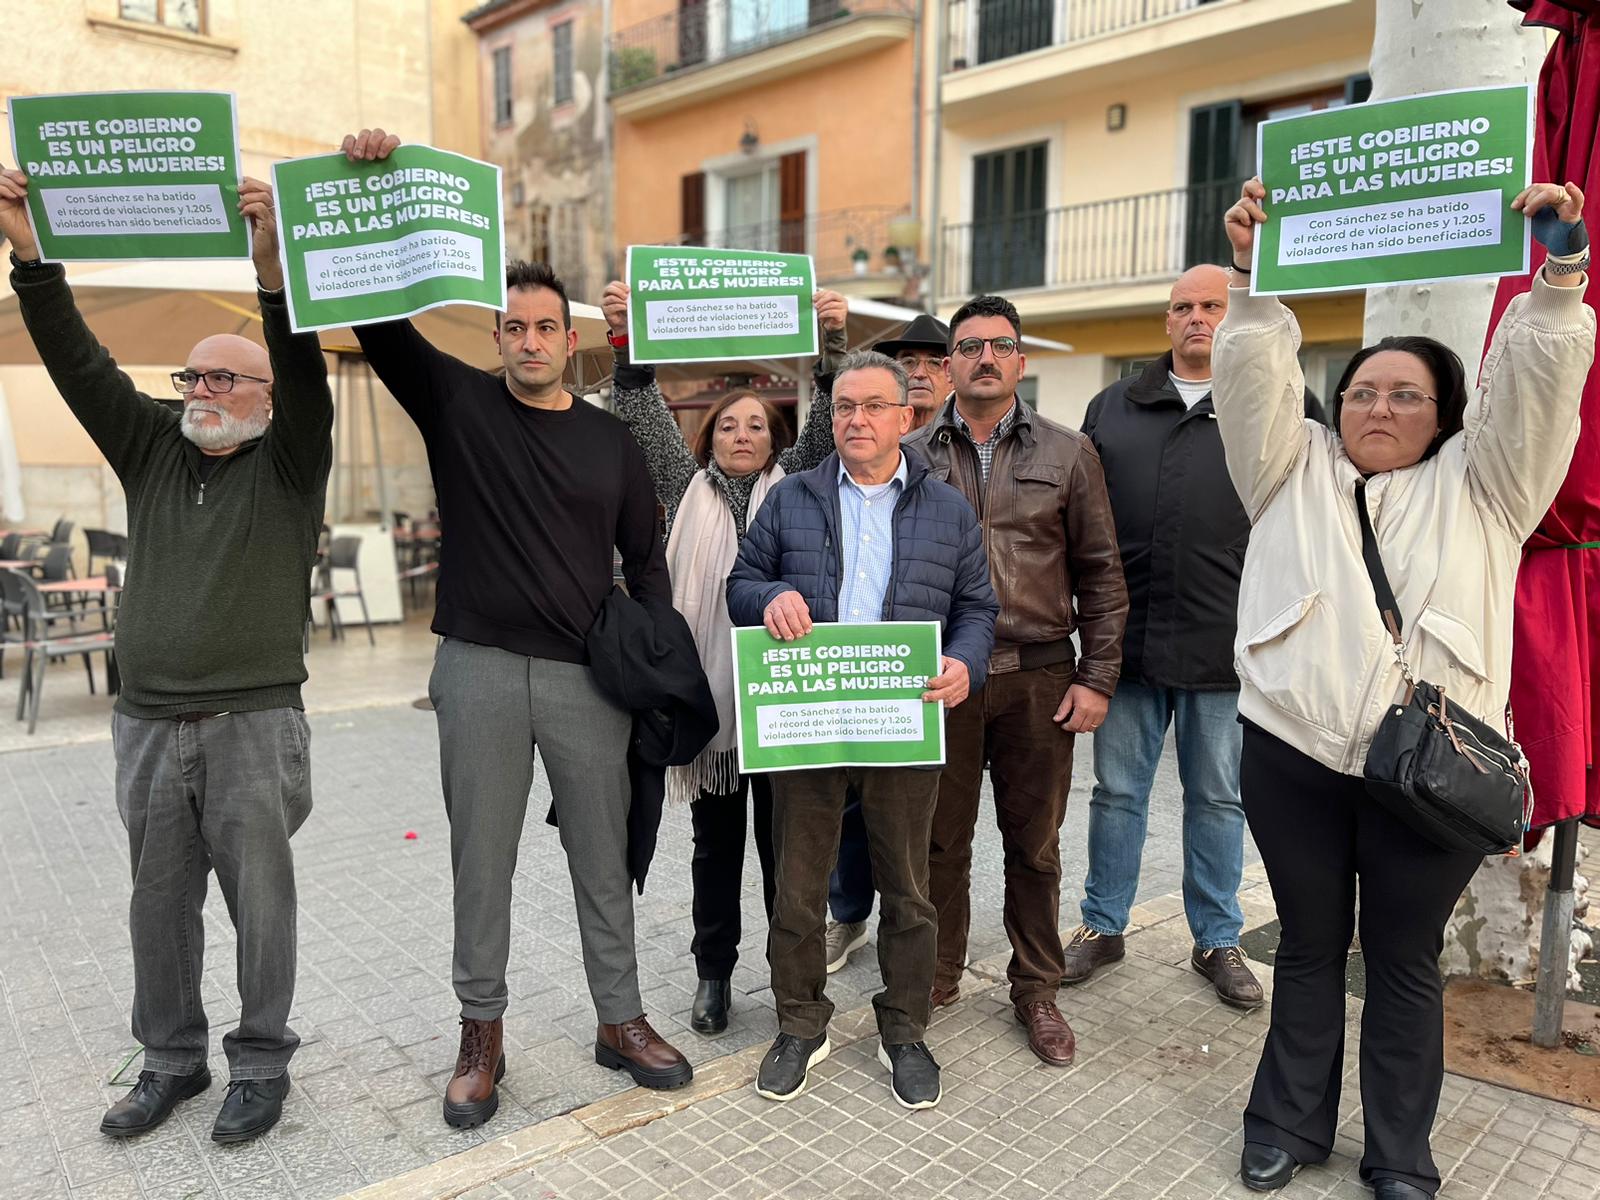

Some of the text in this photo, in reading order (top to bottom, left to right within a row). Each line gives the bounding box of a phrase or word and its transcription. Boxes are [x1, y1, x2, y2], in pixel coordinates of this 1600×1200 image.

[39, 118, 202, 140] ¡ESTE GOBIERNO
[48, 138, 195, 157] ES UN PELIGRO
[1290, 117, 1490, 164] ¡ESTE GOBIERNO
[27, 156, 225, 176] PARA LAS MUJERES!
[1300, 140, 1479, 180] ES UN PELIGRO
[305, 168, 470, 202] ¡ESTE GOBIERNO
[1272, 157, 1513, 205] PARA LAS MUJERES!
[66, 195, 85, 204] Con
[88, 193, 130, 203] Sánchez
[147, 193, 160, 201] ha
[163, 192, 195, 201] batido
[315, 186, 463, 217] ES UN PELIGRO
[58, 205, 212, 216] el récord de violaciones y 1.205
[1309, 201, 1469, 230] Con Sánchez se ha batido
[56, 217, 221, 229] violadores han sido beneficiados
[292, 204, 490, 240] PARA LAS MUJERES!
[1294, 214, 1485, 244] el récord de violaciones y 1.205
[332, 236, 456, 265] Con Sánchez se ha batido
[1286, 228, 1492, 257] violadores han sido beneficiados
[320, 249, 470, 279] el récord de violaciones y 1.205
[653, 258, 787, 268] ¡ESTE GOBIERNO
[660, 268, 679, 276] ES
[684, 268, 707, 276] UN
[316, 261, 477, 292] violadores han sido beneficiados
[638, 277, 803, 291] PARA LAS MUJERES!
[667, 314, 695, 323] récord
[711, 313, 758, 321] violaciones
[686, 304, 722, 312] Sánchez
[653, 326, 697, 334] violadores
[738, 322, 793, 330] beneficiados
[762, 645, 911, 665] ¡ESTE GOBIERNO
[770, 661, 905, 678] ES UN PELIGRO
[748, 676, 928, 696] PARA LAS MUJERES!
[780, 710, 798, 718] Con
[800, 707, 840, 717] Sánchez
[869, 705, 899, 713] batido
[780, 720, 810, 729] récord
[827, 717, 878, 726] violaciones
[889, 716, 912, 724] 1.205
[764, 727, 918, 740] violadores han sido beneficiados
